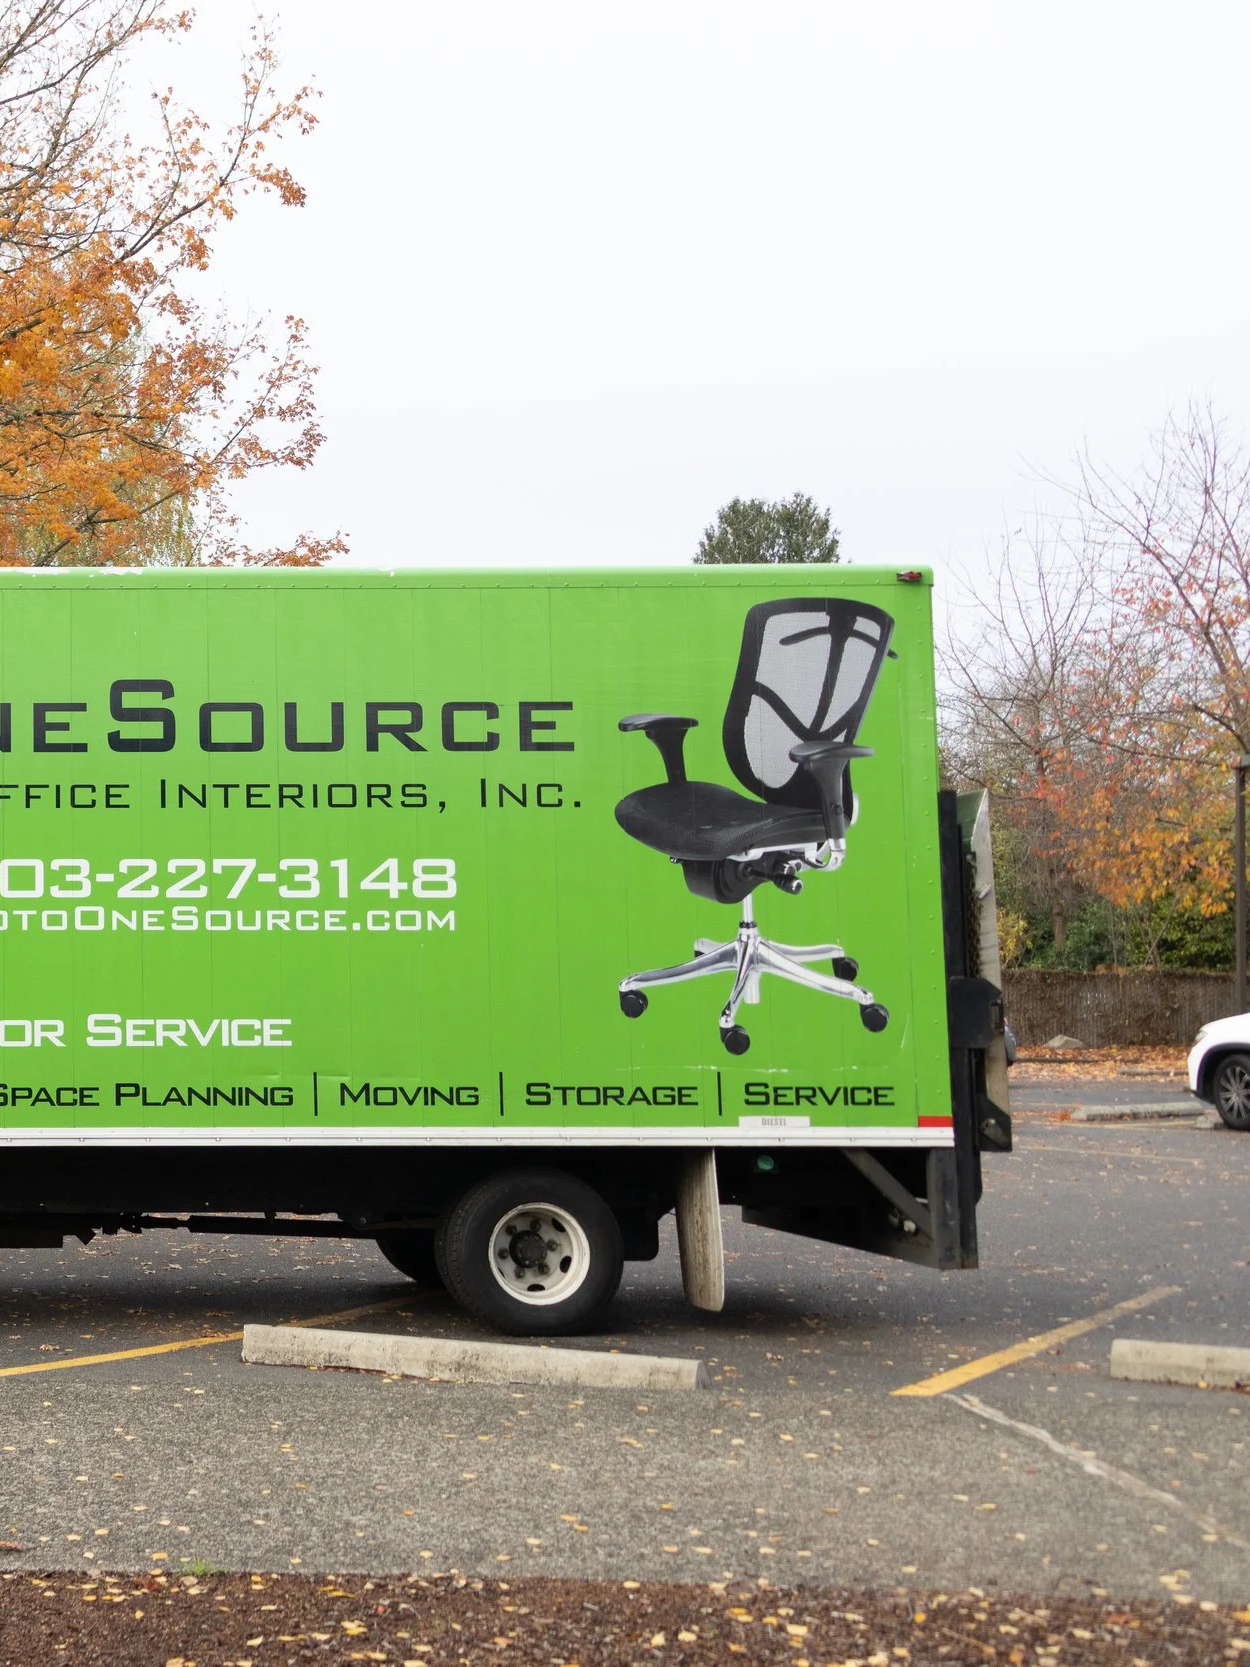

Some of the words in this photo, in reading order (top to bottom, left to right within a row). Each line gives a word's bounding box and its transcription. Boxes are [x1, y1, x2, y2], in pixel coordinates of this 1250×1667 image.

[161, 780, 447, 814] INTERIORS,
[481, 779, 582, 809] INC.
[87, 1014, 293, 1048] SERVICE
[116, 1083, 295, 1107] PLANNING
[340, 1083, 481, 1107] MOVING
[526, 1083, 700, 1107] STORAGE
[745, 1083, 896, 1107] SERVICE
